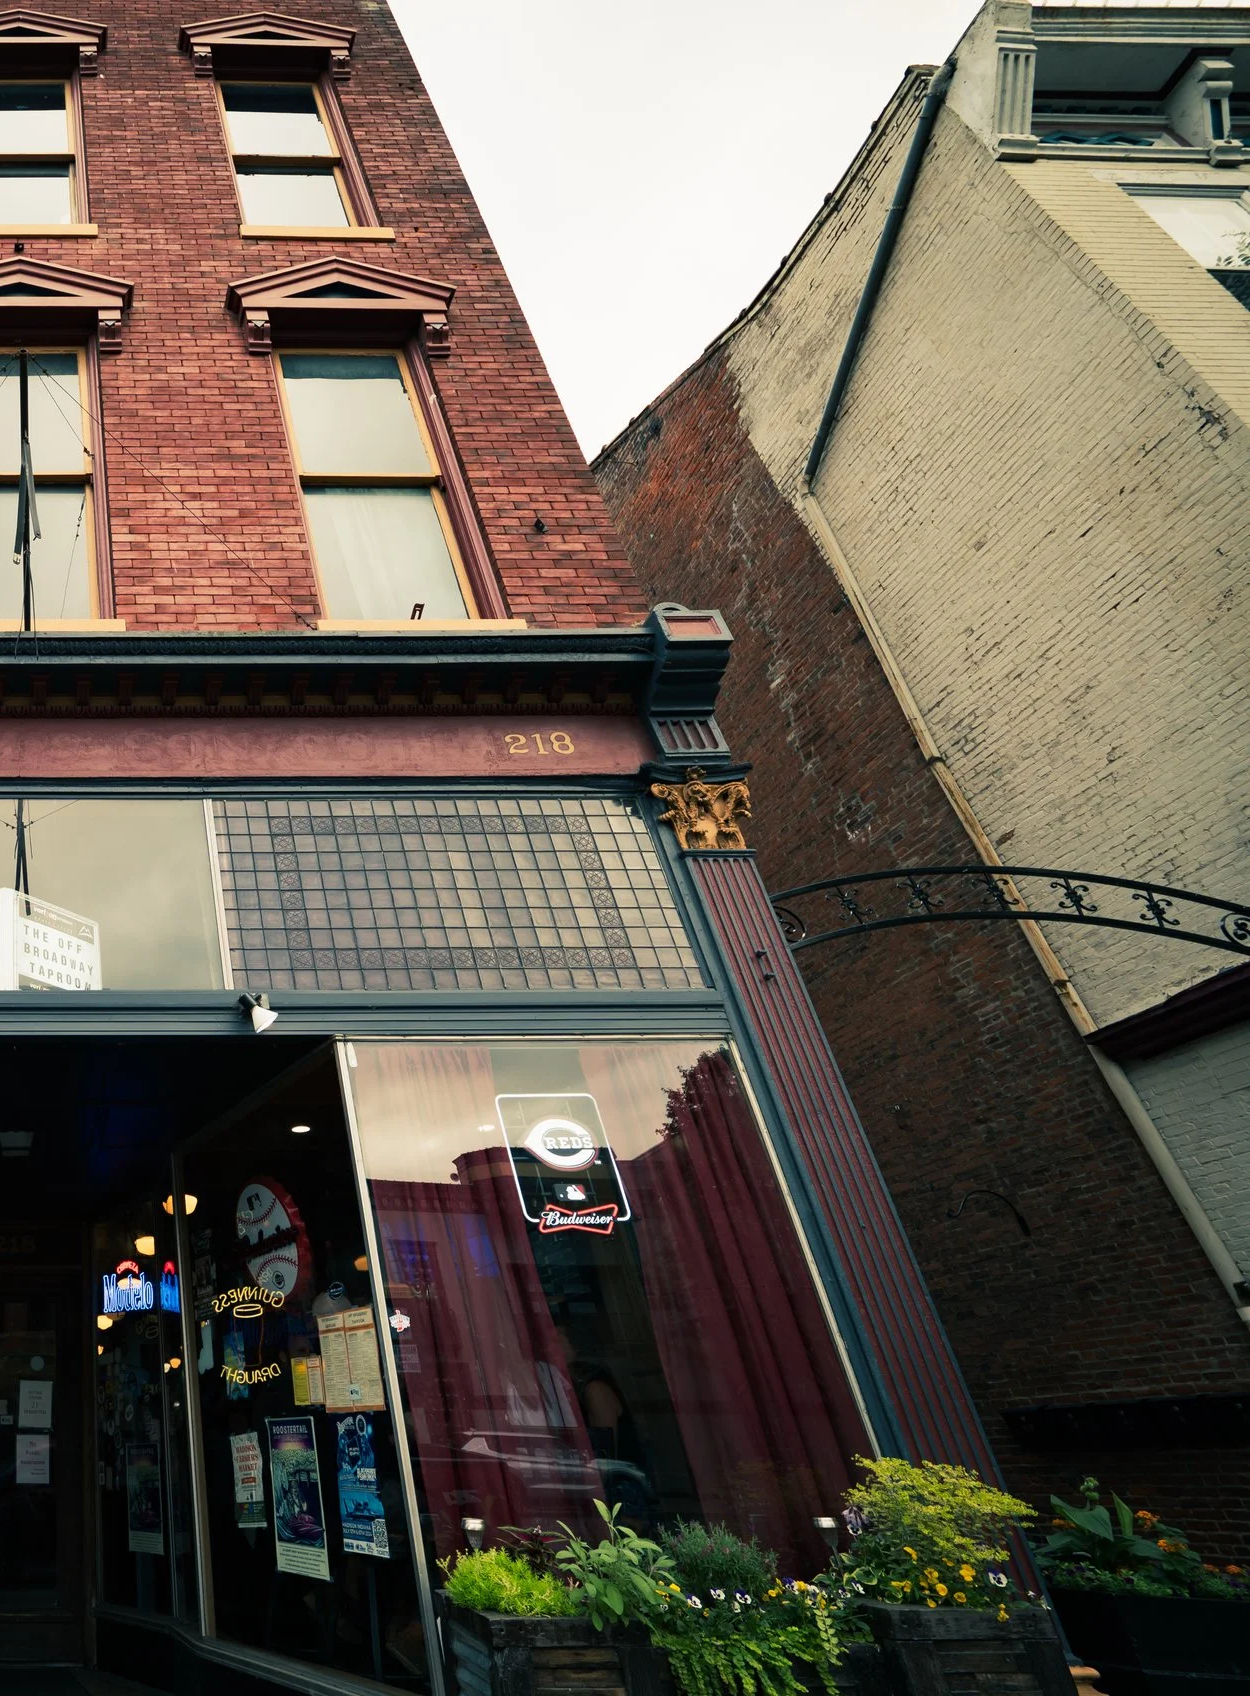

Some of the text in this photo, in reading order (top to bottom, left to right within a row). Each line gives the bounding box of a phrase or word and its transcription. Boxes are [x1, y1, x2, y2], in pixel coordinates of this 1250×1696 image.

[504, 731, 575, 755] 218
[23, 925, 49, 943] THE
[58, 937, 83, 952] OFF
[23, 943, 94, 976] BROADWAY
[544, 1135, 594, 1149] REDS
[541, 1211, 614, 1226] Budweiser
[103, 1272, 154, 1313] Modelo
[272, 1425, 309, 1434] ROOSTERTAIL
